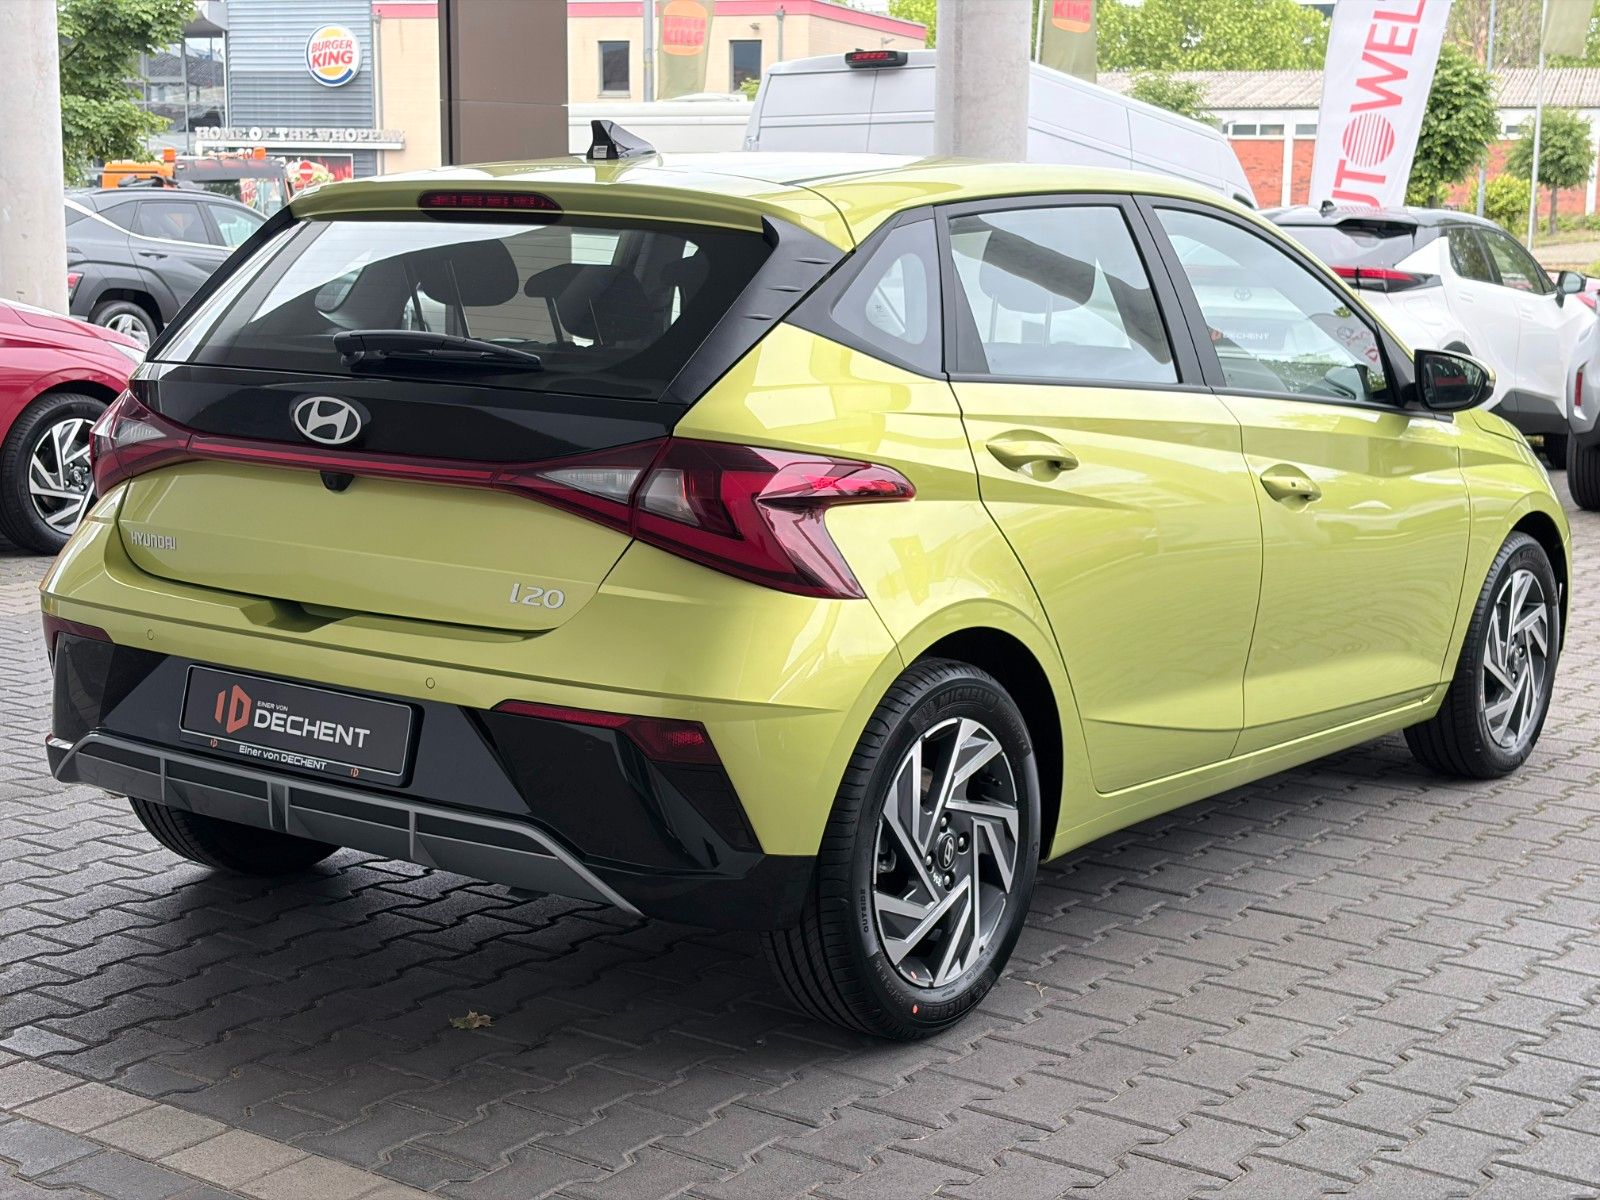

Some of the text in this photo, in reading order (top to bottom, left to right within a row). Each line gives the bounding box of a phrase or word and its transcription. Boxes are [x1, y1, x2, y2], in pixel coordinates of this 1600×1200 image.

[311, 39, 353, 53] BURGER
[312, 50, 353, 69] KING
[195, 126, 246, 140] HOME
[249, 126, 273, 141] OF
[275, 127, 313, 141] THE
[131, 530, 176, 550] HYUNDAI
[257, 700, 289, 712] EINER VON
[253, 709, 371, 748] DECHENT
[239, 744, 327, 771] Einer von DECHENT
